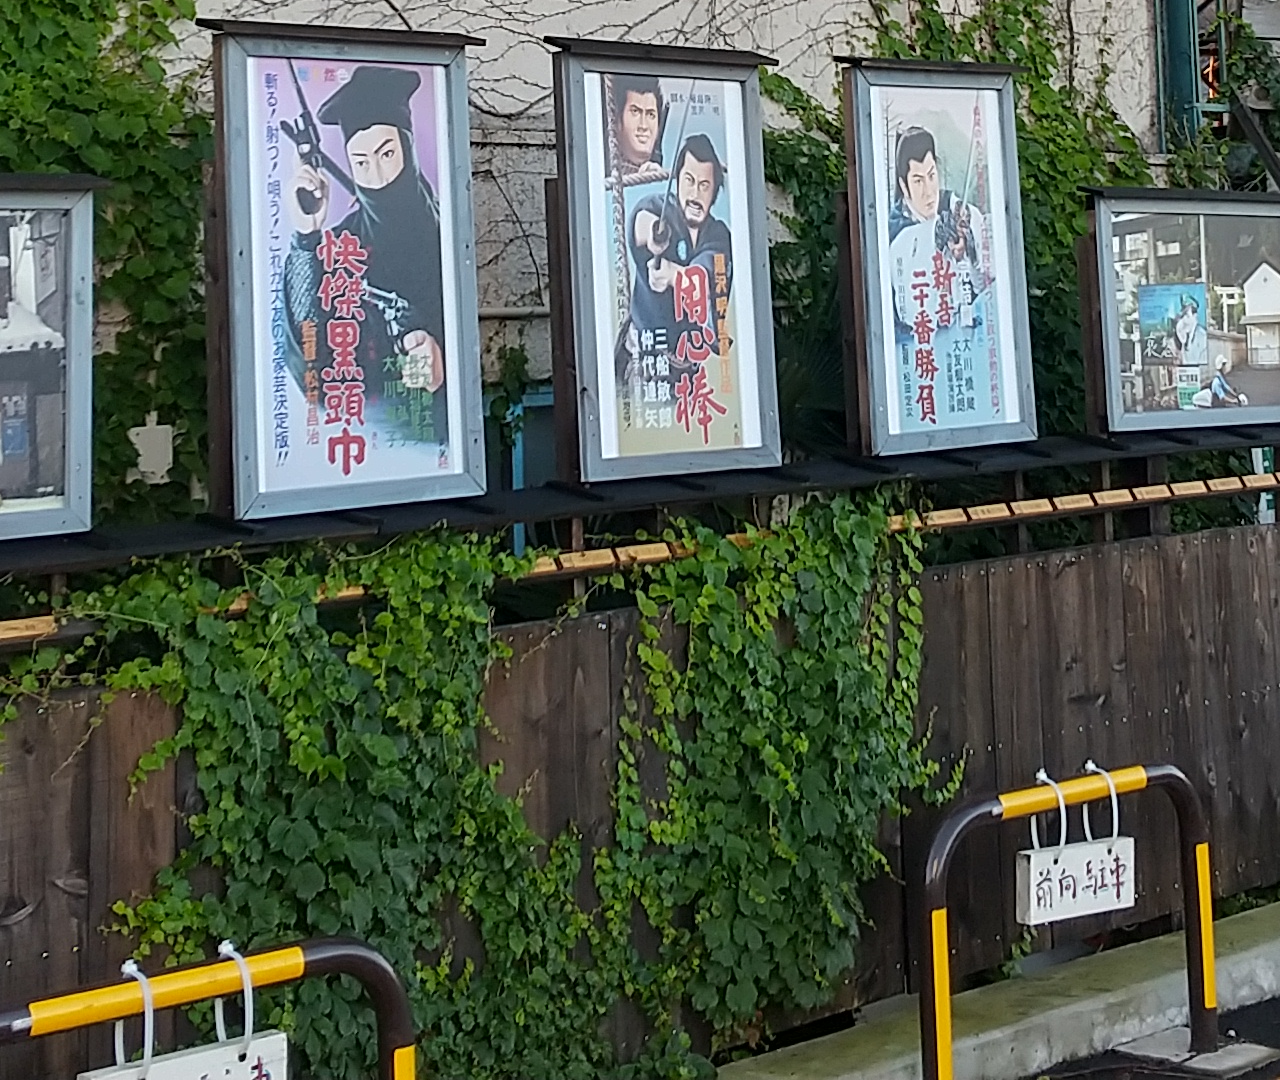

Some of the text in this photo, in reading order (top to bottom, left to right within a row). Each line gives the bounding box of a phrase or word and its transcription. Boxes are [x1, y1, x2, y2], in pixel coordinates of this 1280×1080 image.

[655, 328, 673, 429] 三船敏郎
[673, 265, 728, 446] 用心棒
[911, 270, 940, 426] 二十番勝負
[1036, 855, 1127, 911] 前向駐車
